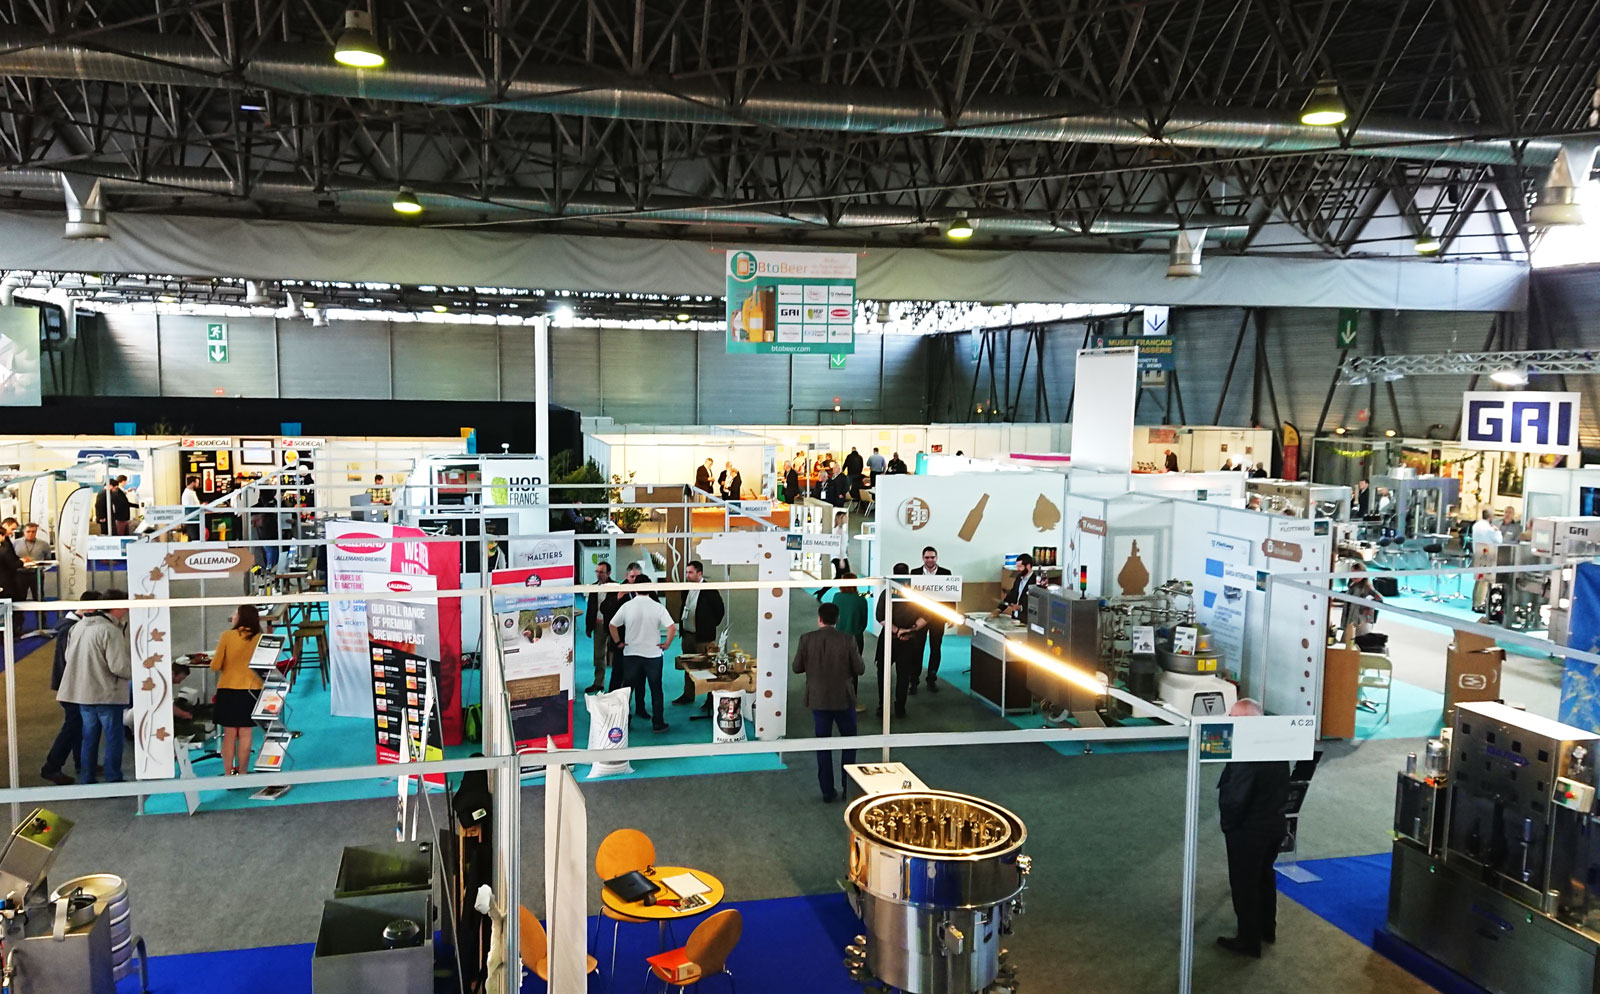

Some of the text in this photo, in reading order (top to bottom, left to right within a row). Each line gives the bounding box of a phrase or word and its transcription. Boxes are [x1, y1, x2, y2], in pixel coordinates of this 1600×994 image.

[758, 261, 808, 274] BtoBeer
[781, 308, 799, 317] GAI
[1468, 400, 1572, 446] GAI
[509, 477, 542, 491] HOP
[509, 492, 540, 505] FRANCE
[1569, 526, 1589, 536] GAI
[189, 556, 238, 566] LALLEMAND
[527, 551, 563, 561] MALTIERS
[388, 582, 412, 590] LALLEMAND
[371, 603, 426, 619] OUR FULL RANGE
[372, 616, 413, 630] OF PREMIUM
[373, 629, 402, 643] BREWING
[403, 632, 426, 645] YEAST
